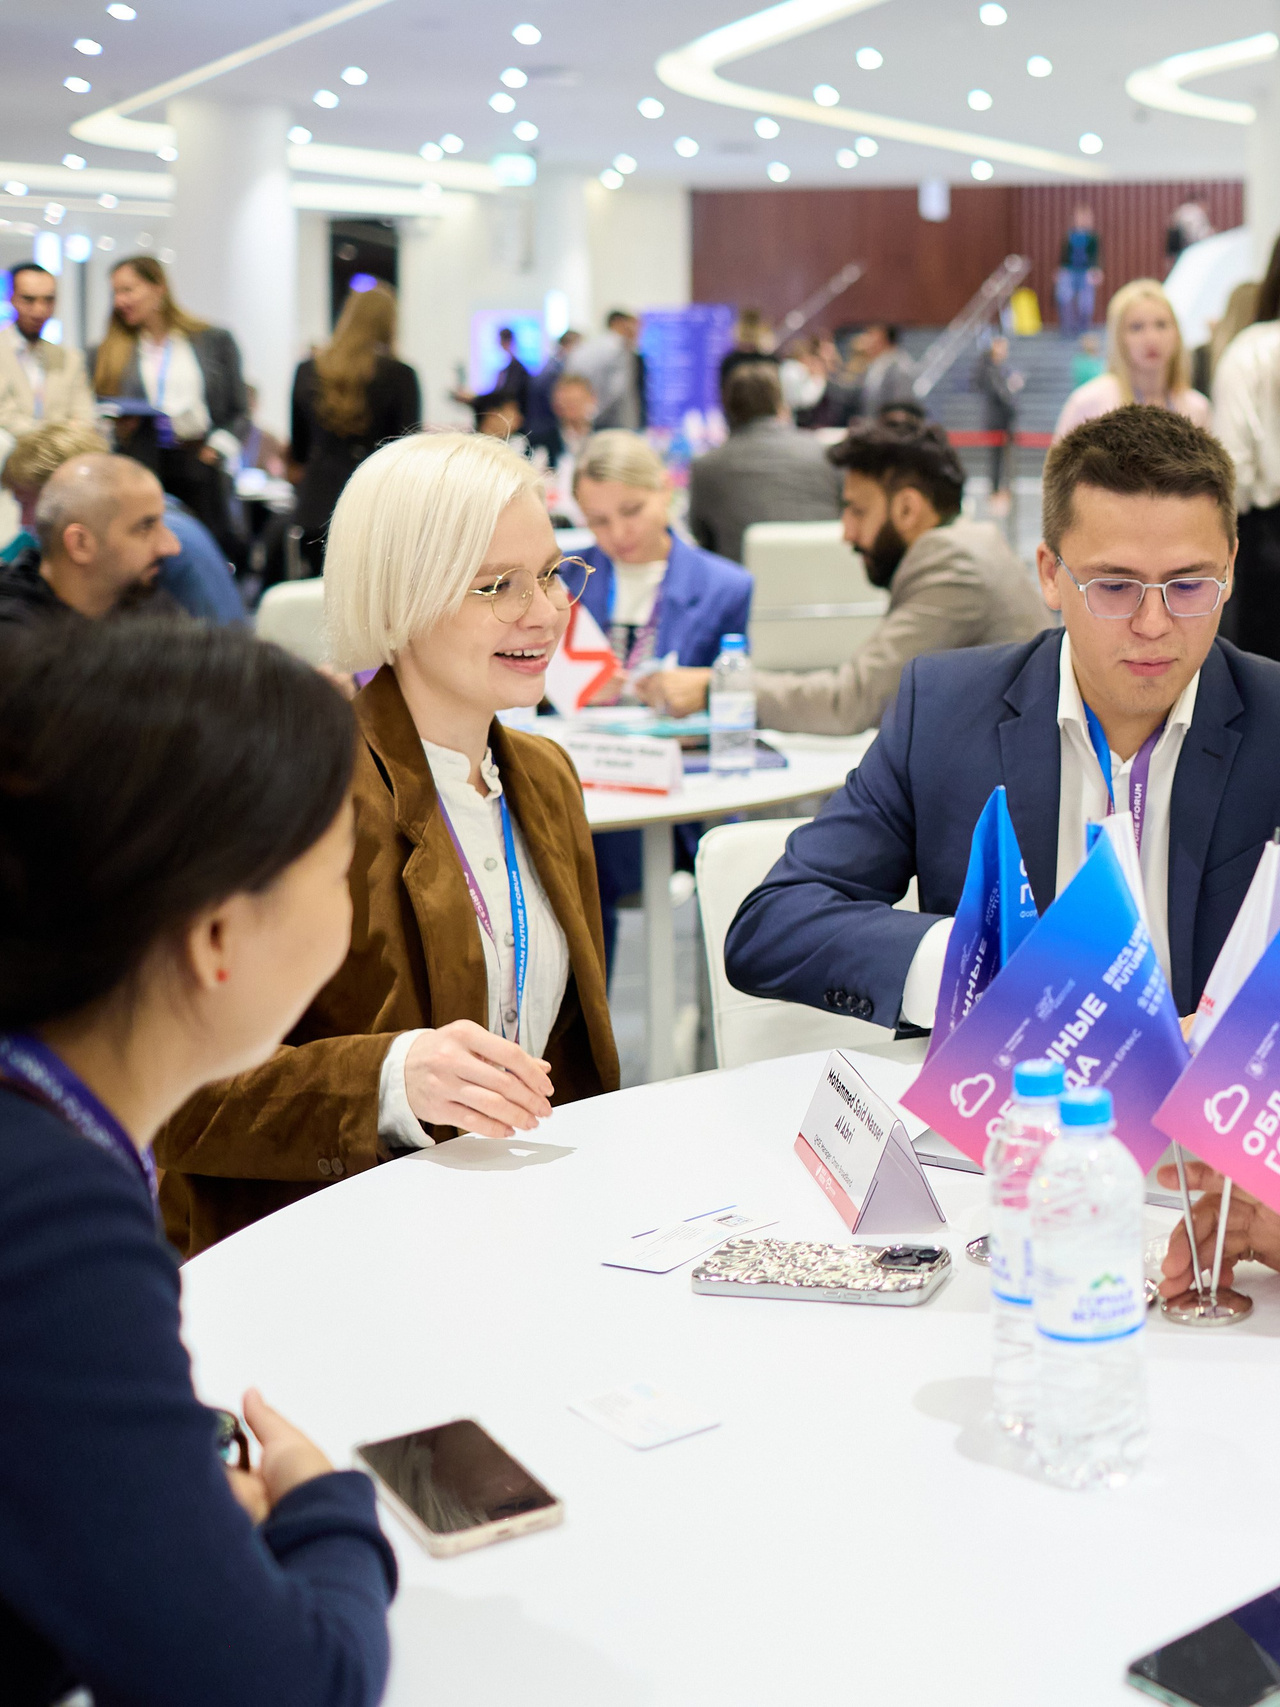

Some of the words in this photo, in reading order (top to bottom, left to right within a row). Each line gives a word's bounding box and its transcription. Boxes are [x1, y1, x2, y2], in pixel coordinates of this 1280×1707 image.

[1133, 783, 1143, 819] FORUM
[469, 889, 485, 921] BRICS
[512, 870, 522, 906] FORUM
[518, 908, 526, 949] FUTURE
[1020, 909, 1037, 918] Фор
[962, 937, 987, 1017] ЧНЫЕ
[1102, 946, 1134, 985] BRICS
[1112, 942, 1148, 993] FUTURE
[827, 1068, 857, 1109] Mohammed
[853, 1099, 868, 1122] Said
[865, 1112, 883, 1142] Nasser
[834, 1115, 845, 1131] Al
[840, 1122, 855, 1144] Abri
